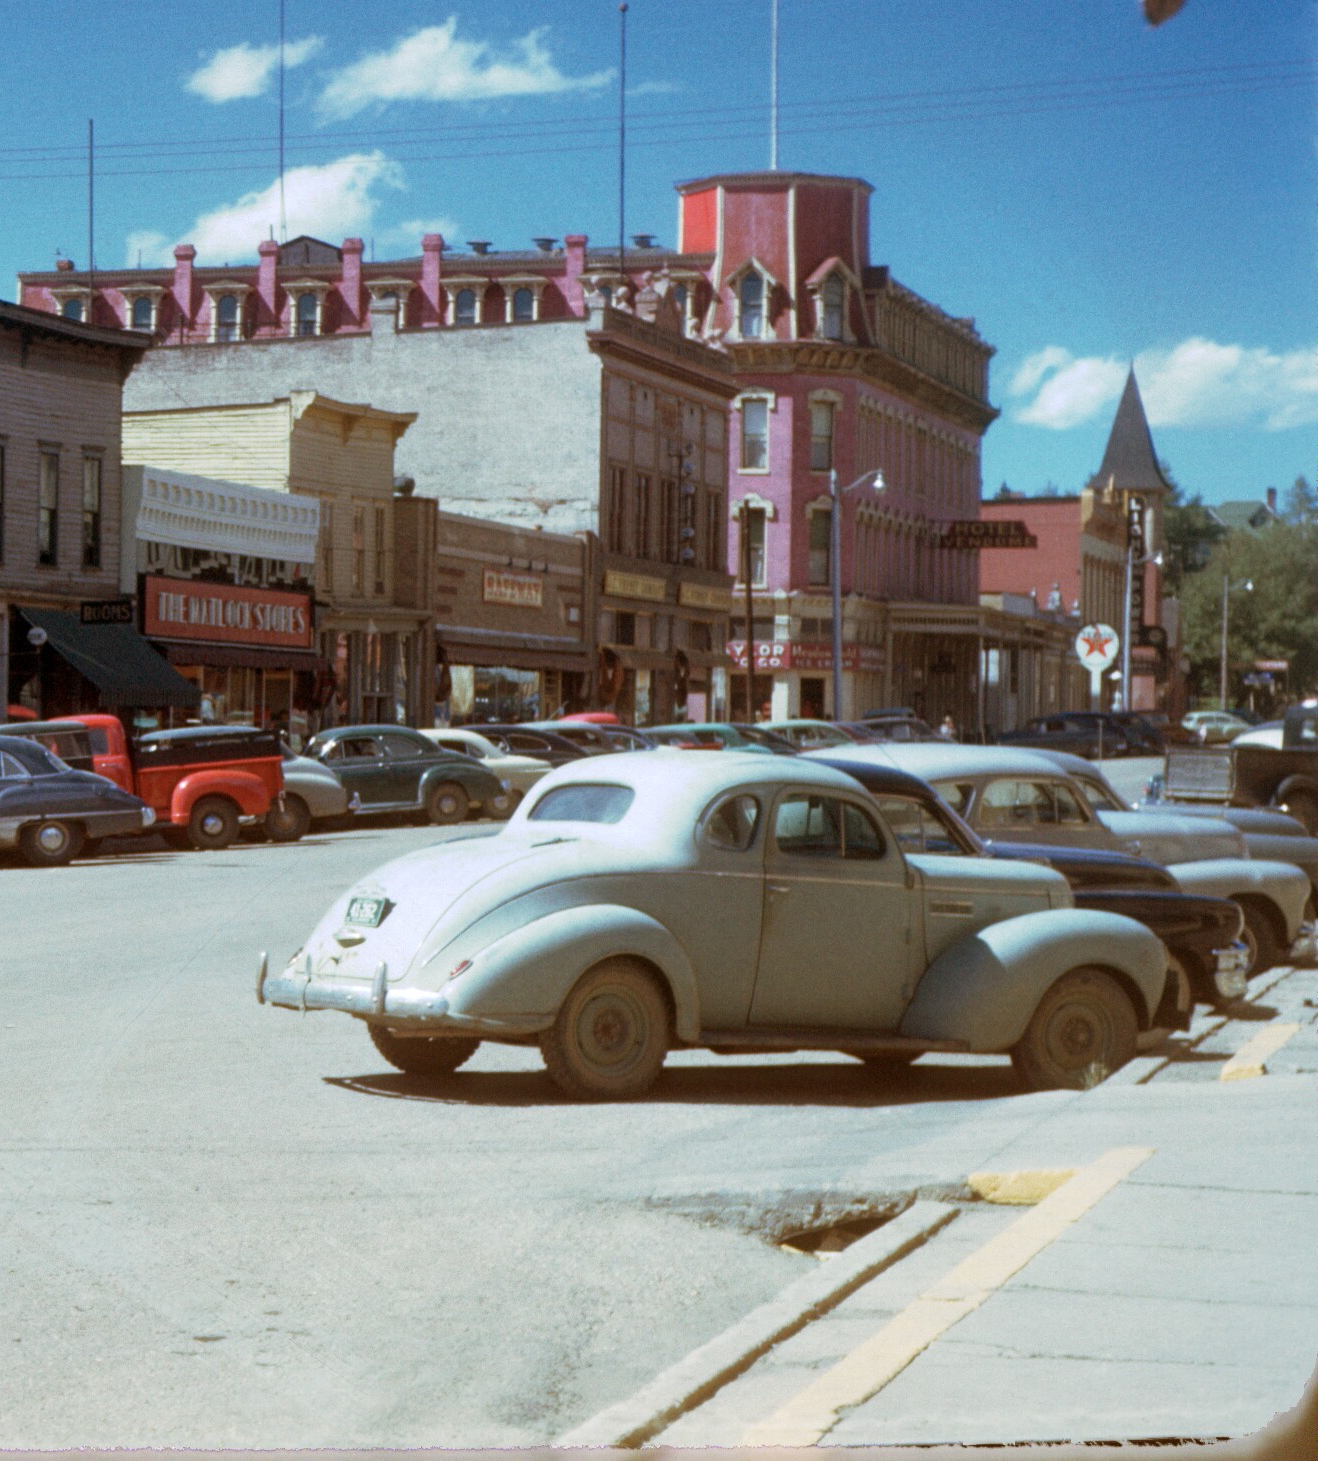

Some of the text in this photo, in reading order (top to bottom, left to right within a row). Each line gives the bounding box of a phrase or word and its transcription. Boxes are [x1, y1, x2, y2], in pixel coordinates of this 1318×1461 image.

[955, 520, 1019, 535] HOTEL
[83, 604, 131, 622] ROOMS
[158, 591, 306, 634] THE MATLOCK STORES
